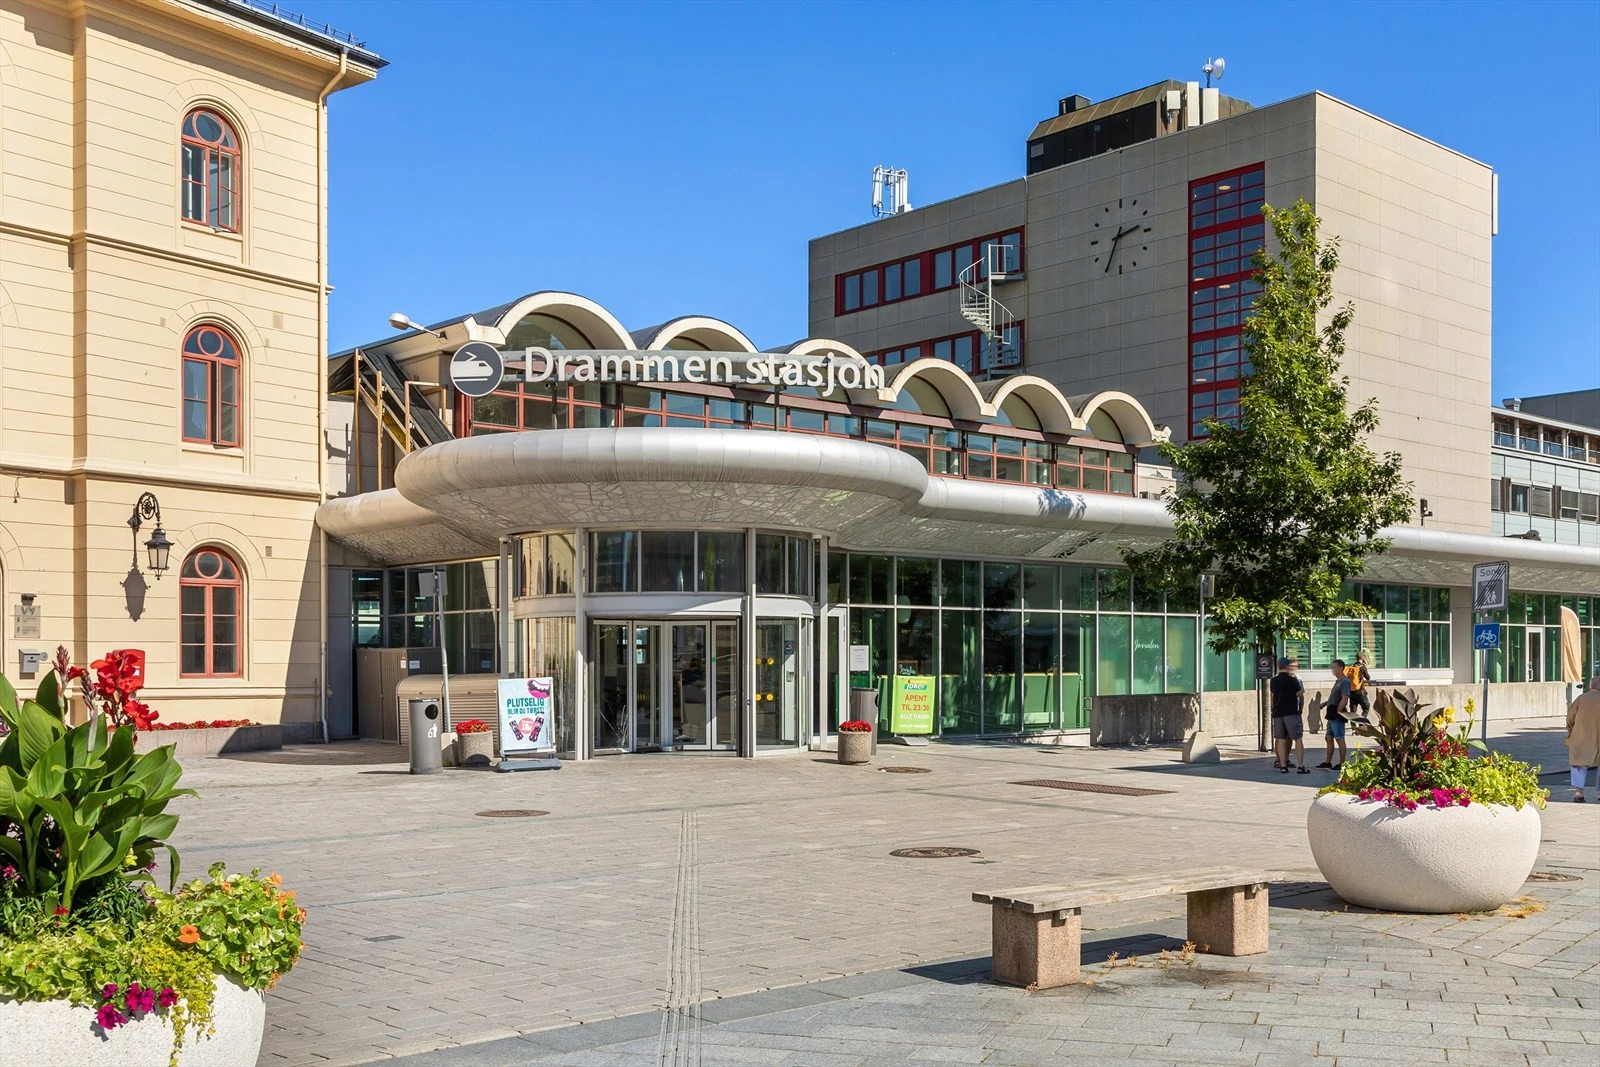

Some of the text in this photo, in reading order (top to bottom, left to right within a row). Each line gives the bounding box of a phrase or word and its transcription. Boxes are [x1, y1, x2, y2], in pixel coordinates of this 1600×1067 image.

[525, 346, 885, 397] Drammen stasjon
[507, 697, 545, 708] PLUTSELIG
[905, 694, 928, 702] ÅPENT
